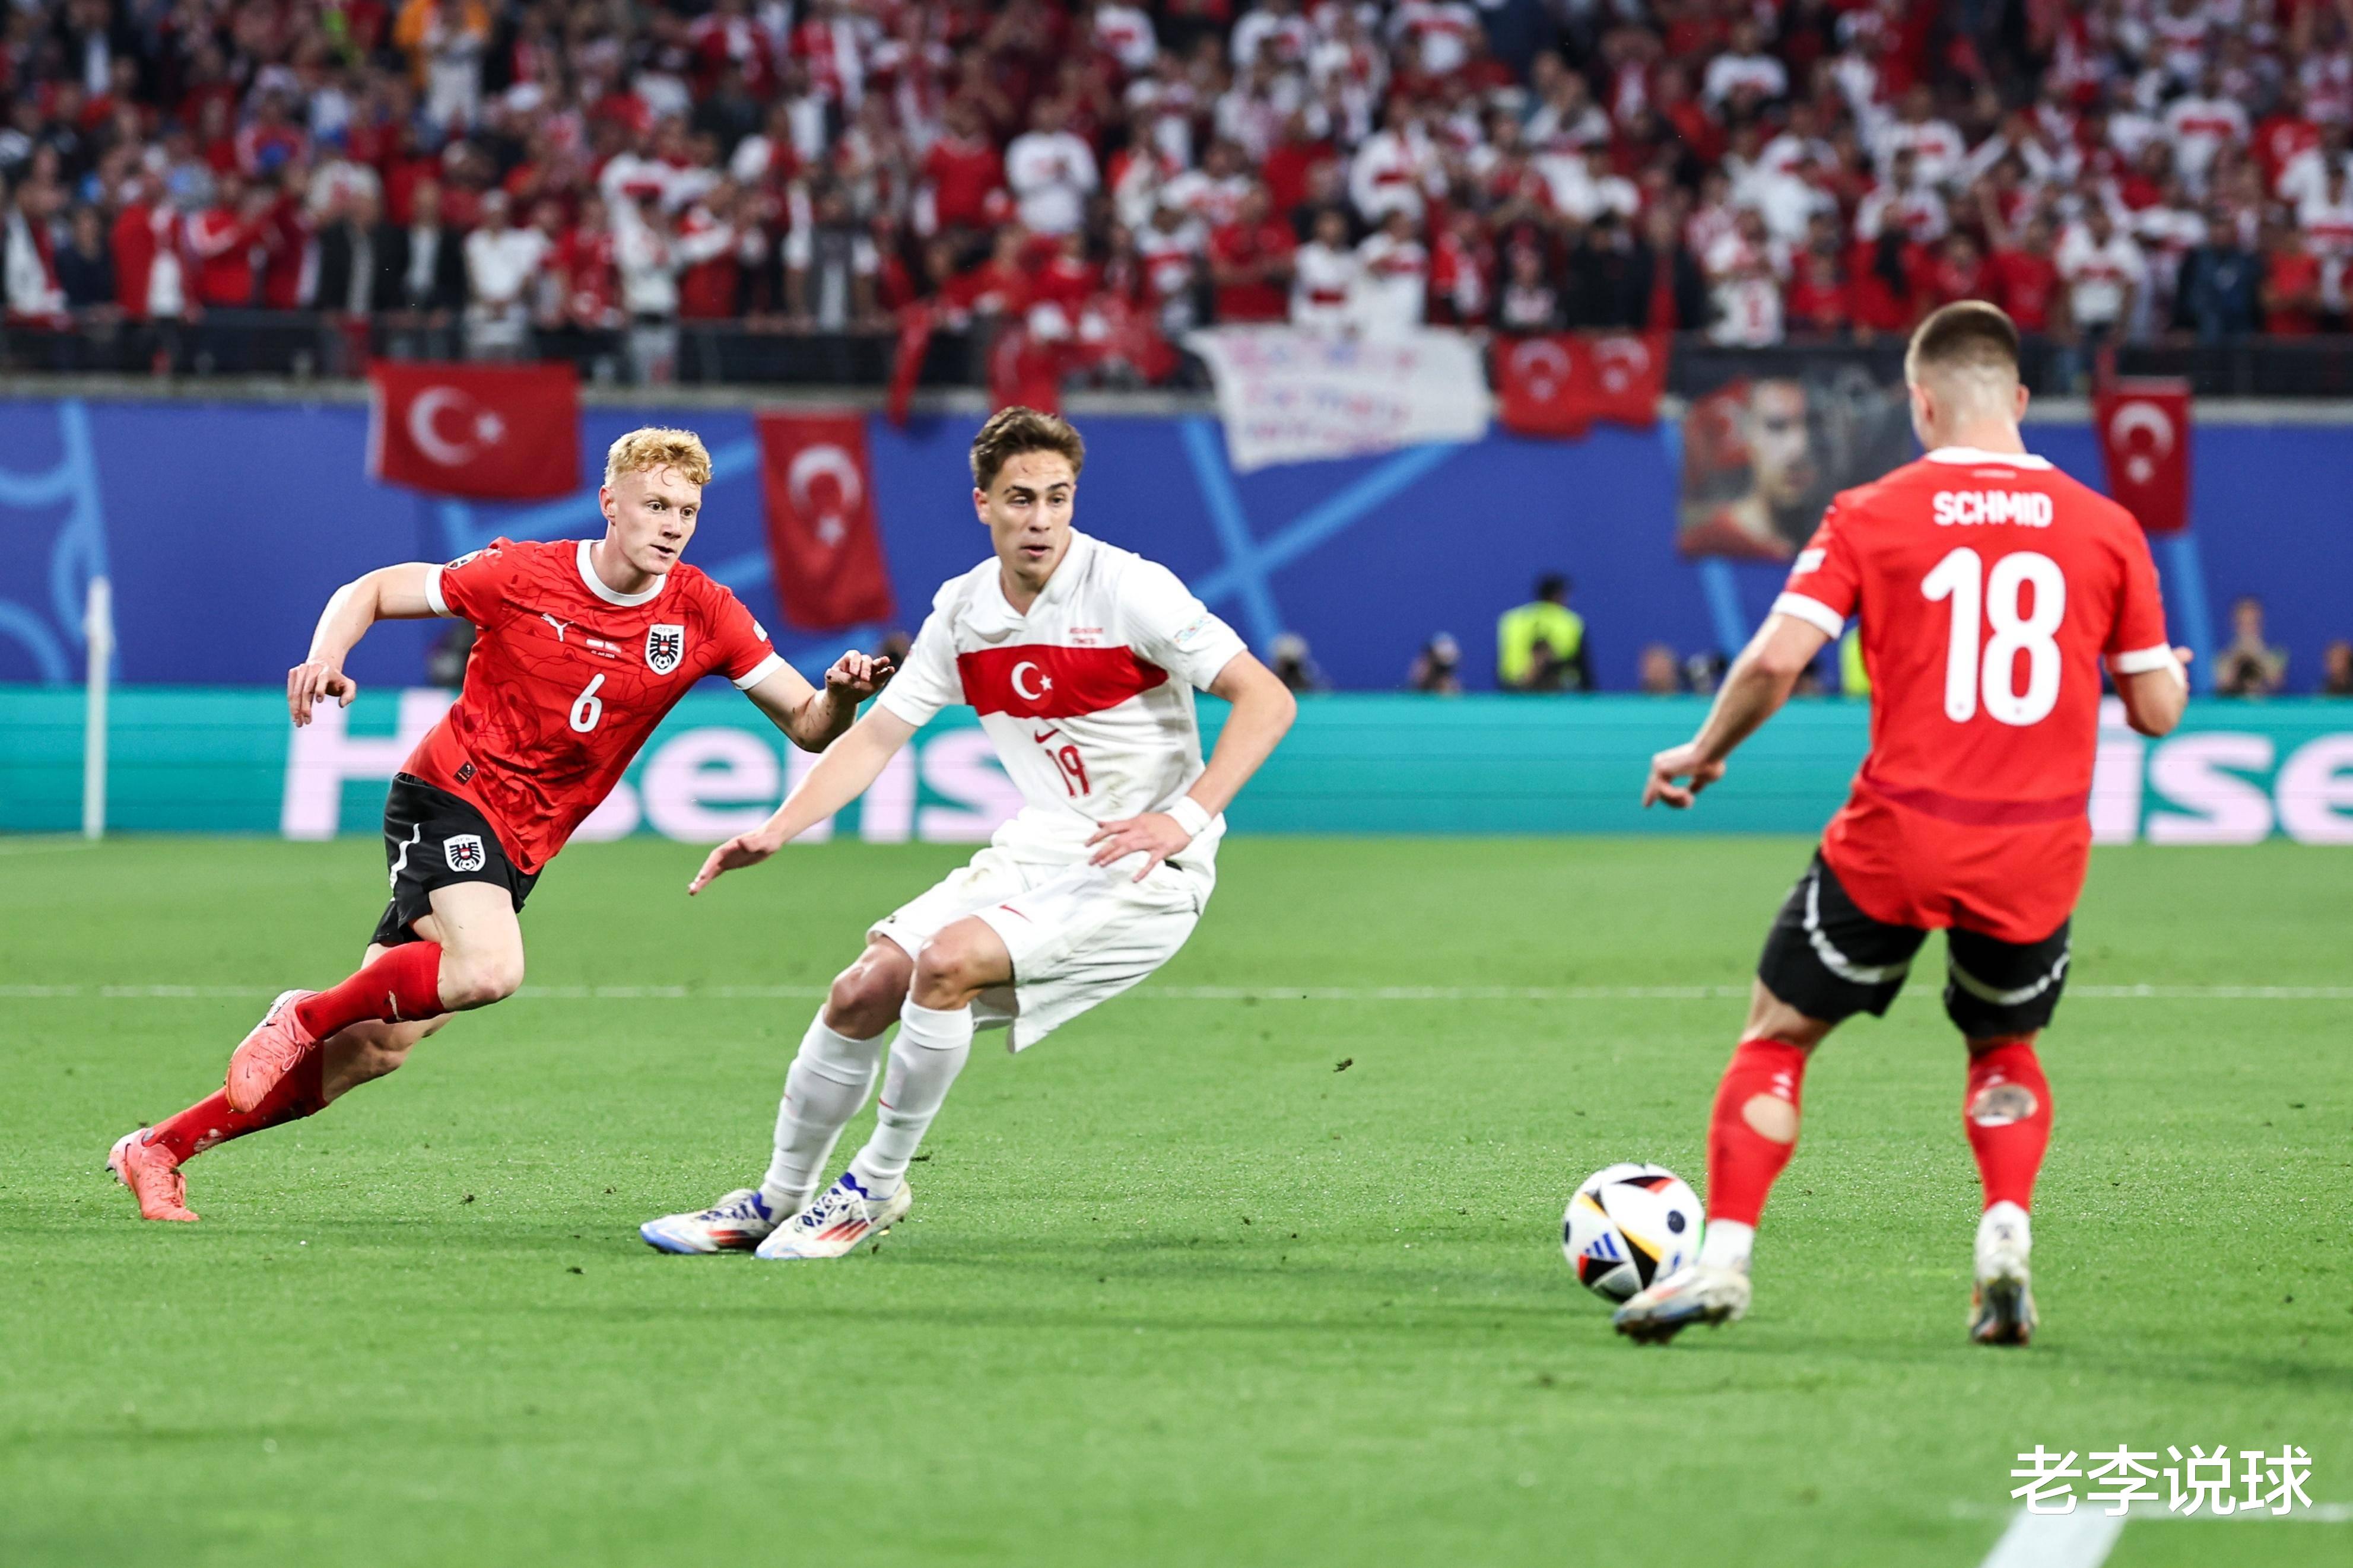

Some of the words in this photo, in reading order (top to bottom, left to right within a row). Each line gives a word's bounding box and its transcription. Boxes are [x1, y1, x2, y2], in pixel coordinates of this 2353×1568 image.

[1933, 489, 2053, 528] SCHMID
[1921, 547, 2066, 726] 18
[569, 672, 606, 733] 6
[281, 688, 1029, 842] Hens
[1045, 745, 1091, 798] 19
